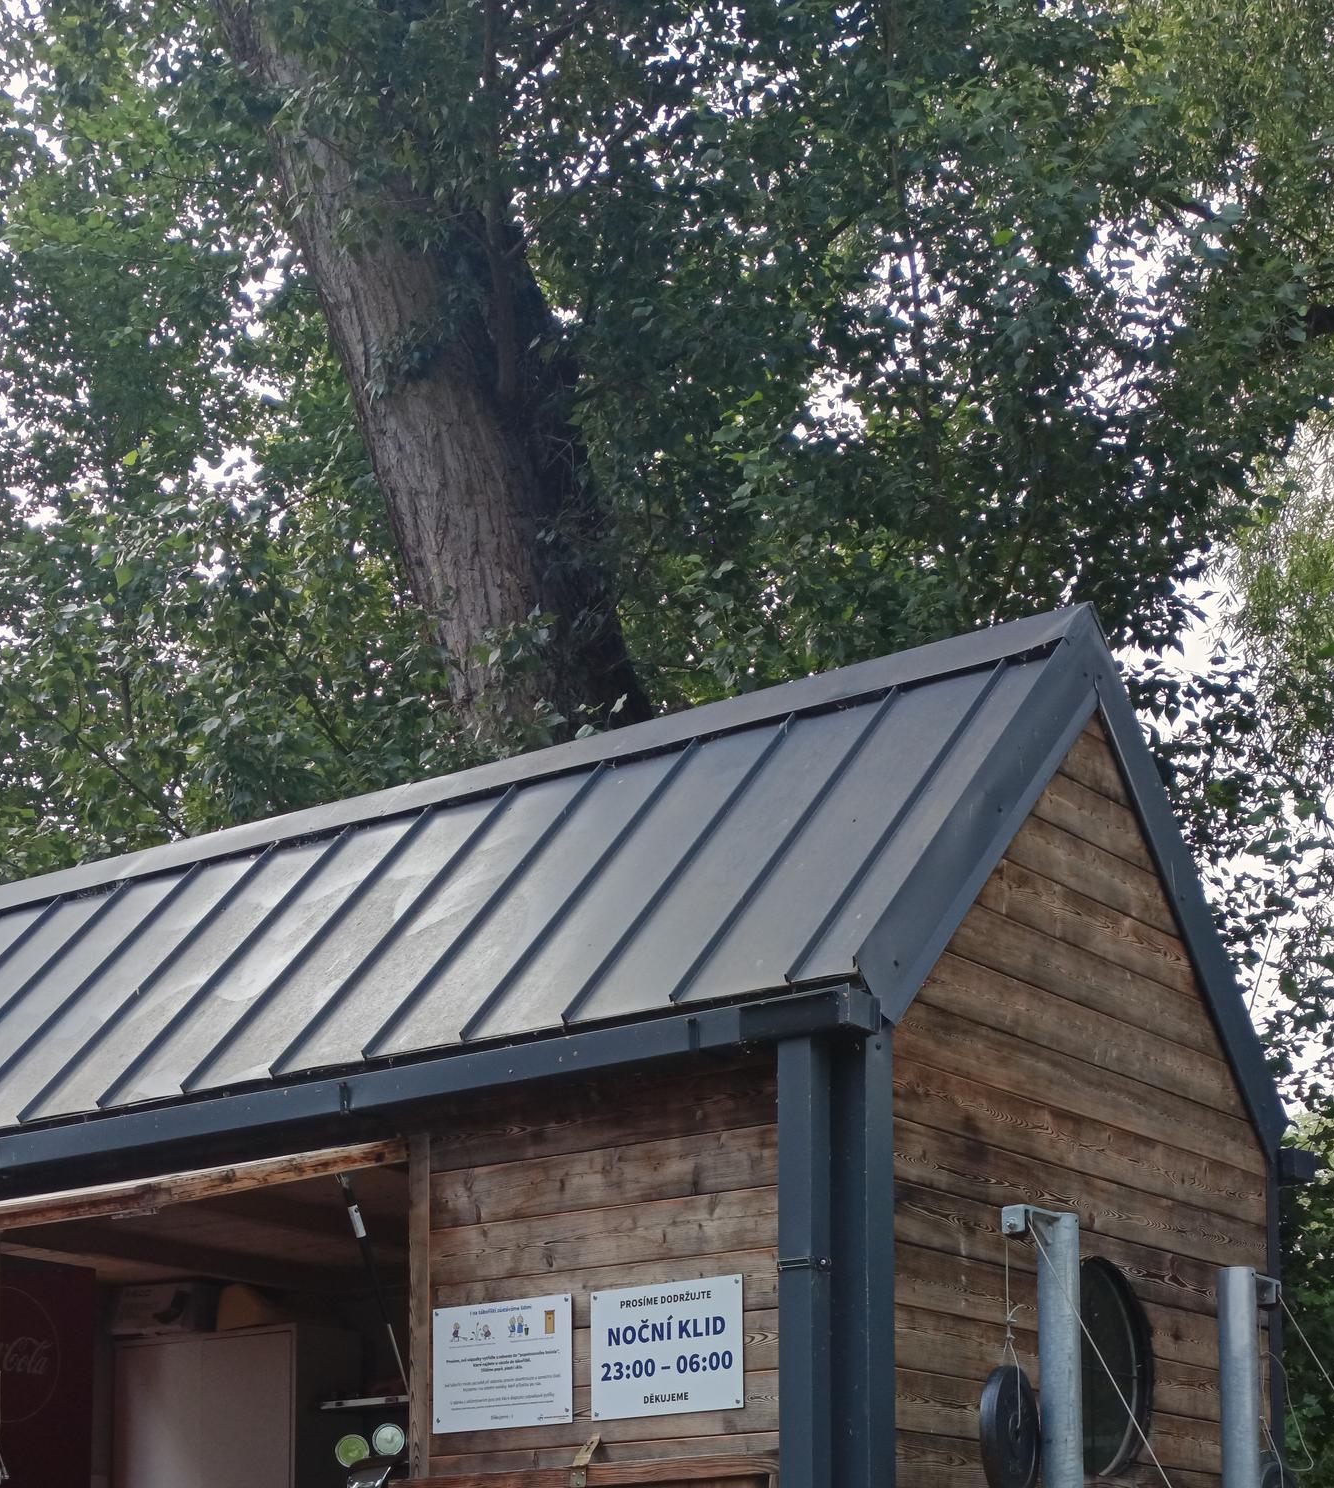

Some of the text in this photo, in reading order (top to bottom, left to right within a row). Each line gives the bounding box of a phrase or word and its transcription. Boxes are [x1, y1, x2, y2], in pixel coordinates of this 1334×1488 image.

[620, 1290, 712, 1309] PROSÍME DODRŽUJTE
[608, 1315, 726, 1347] NOČNÍ KLID
[601, 1358, 656, 1381] 23:00
[676, 1350, 733, 1374] 06:00
[643, 1392, 689, 1404] DĚKUJEME
